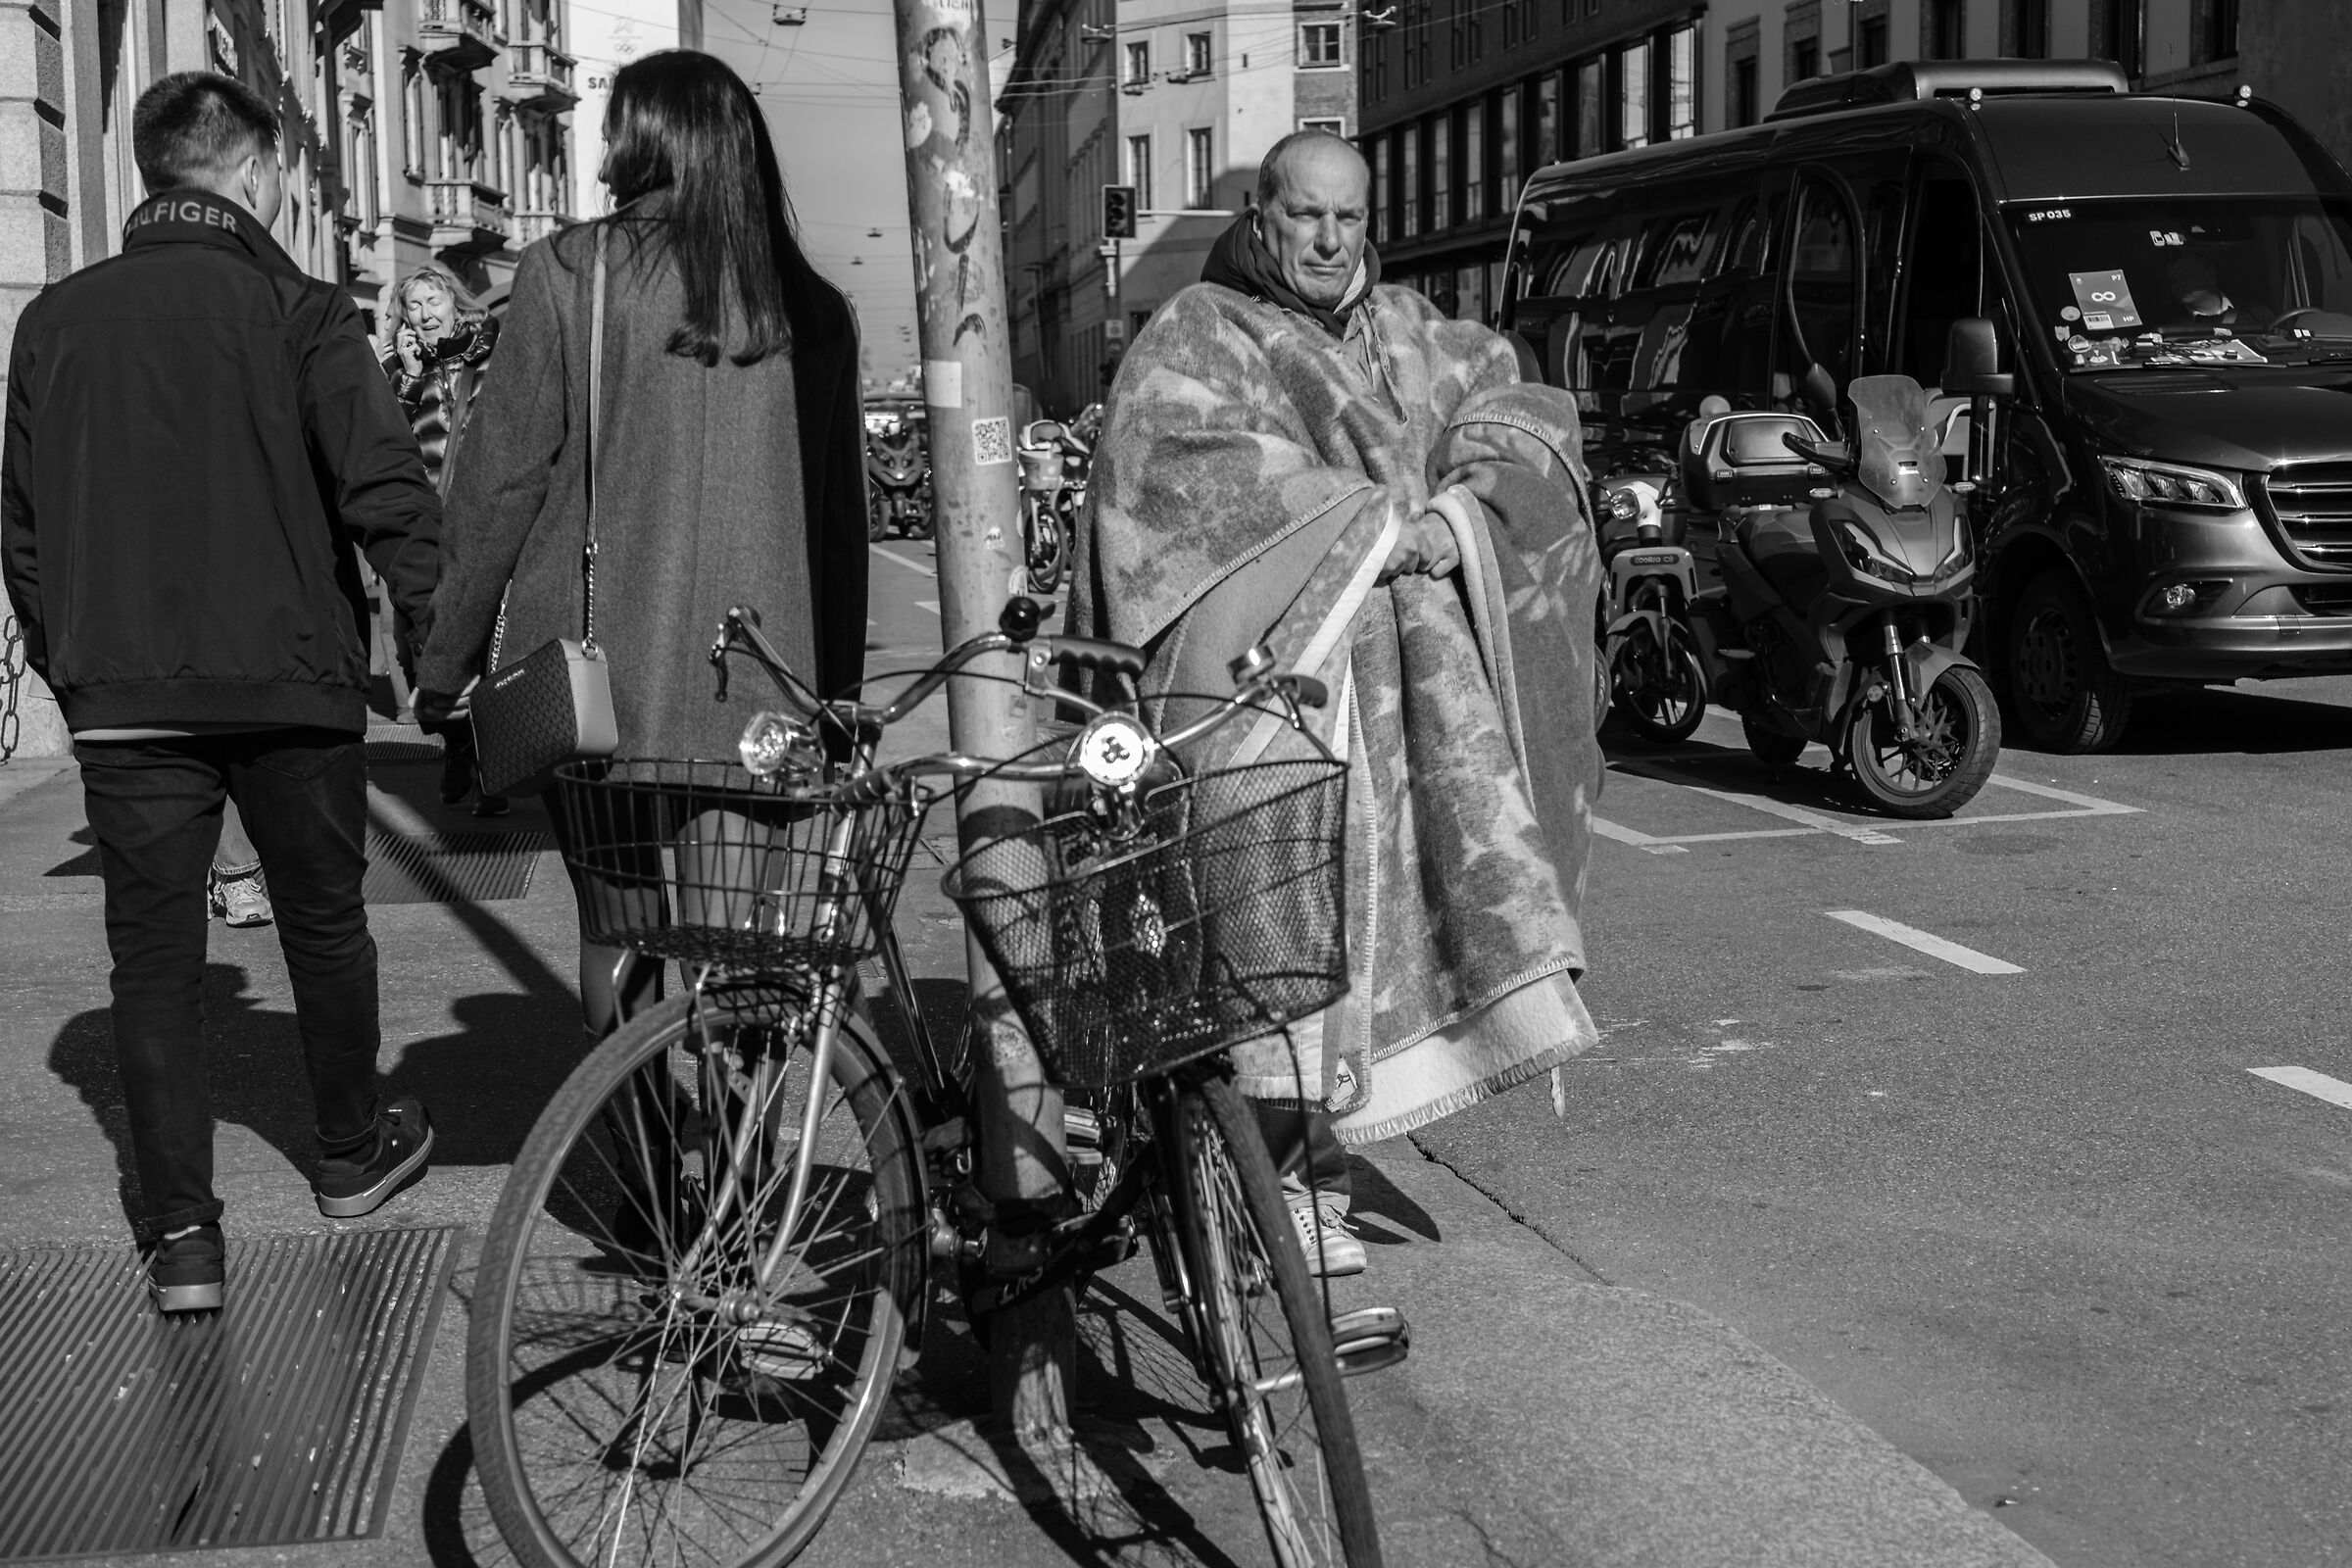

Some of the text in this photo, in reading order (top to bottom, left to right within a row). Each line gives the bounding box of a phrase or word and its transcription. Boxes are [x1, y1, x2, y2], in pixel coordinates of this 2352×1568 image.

[588, 77, 607, 89] SA
[2029, 209, 2072, 222] SP 035
